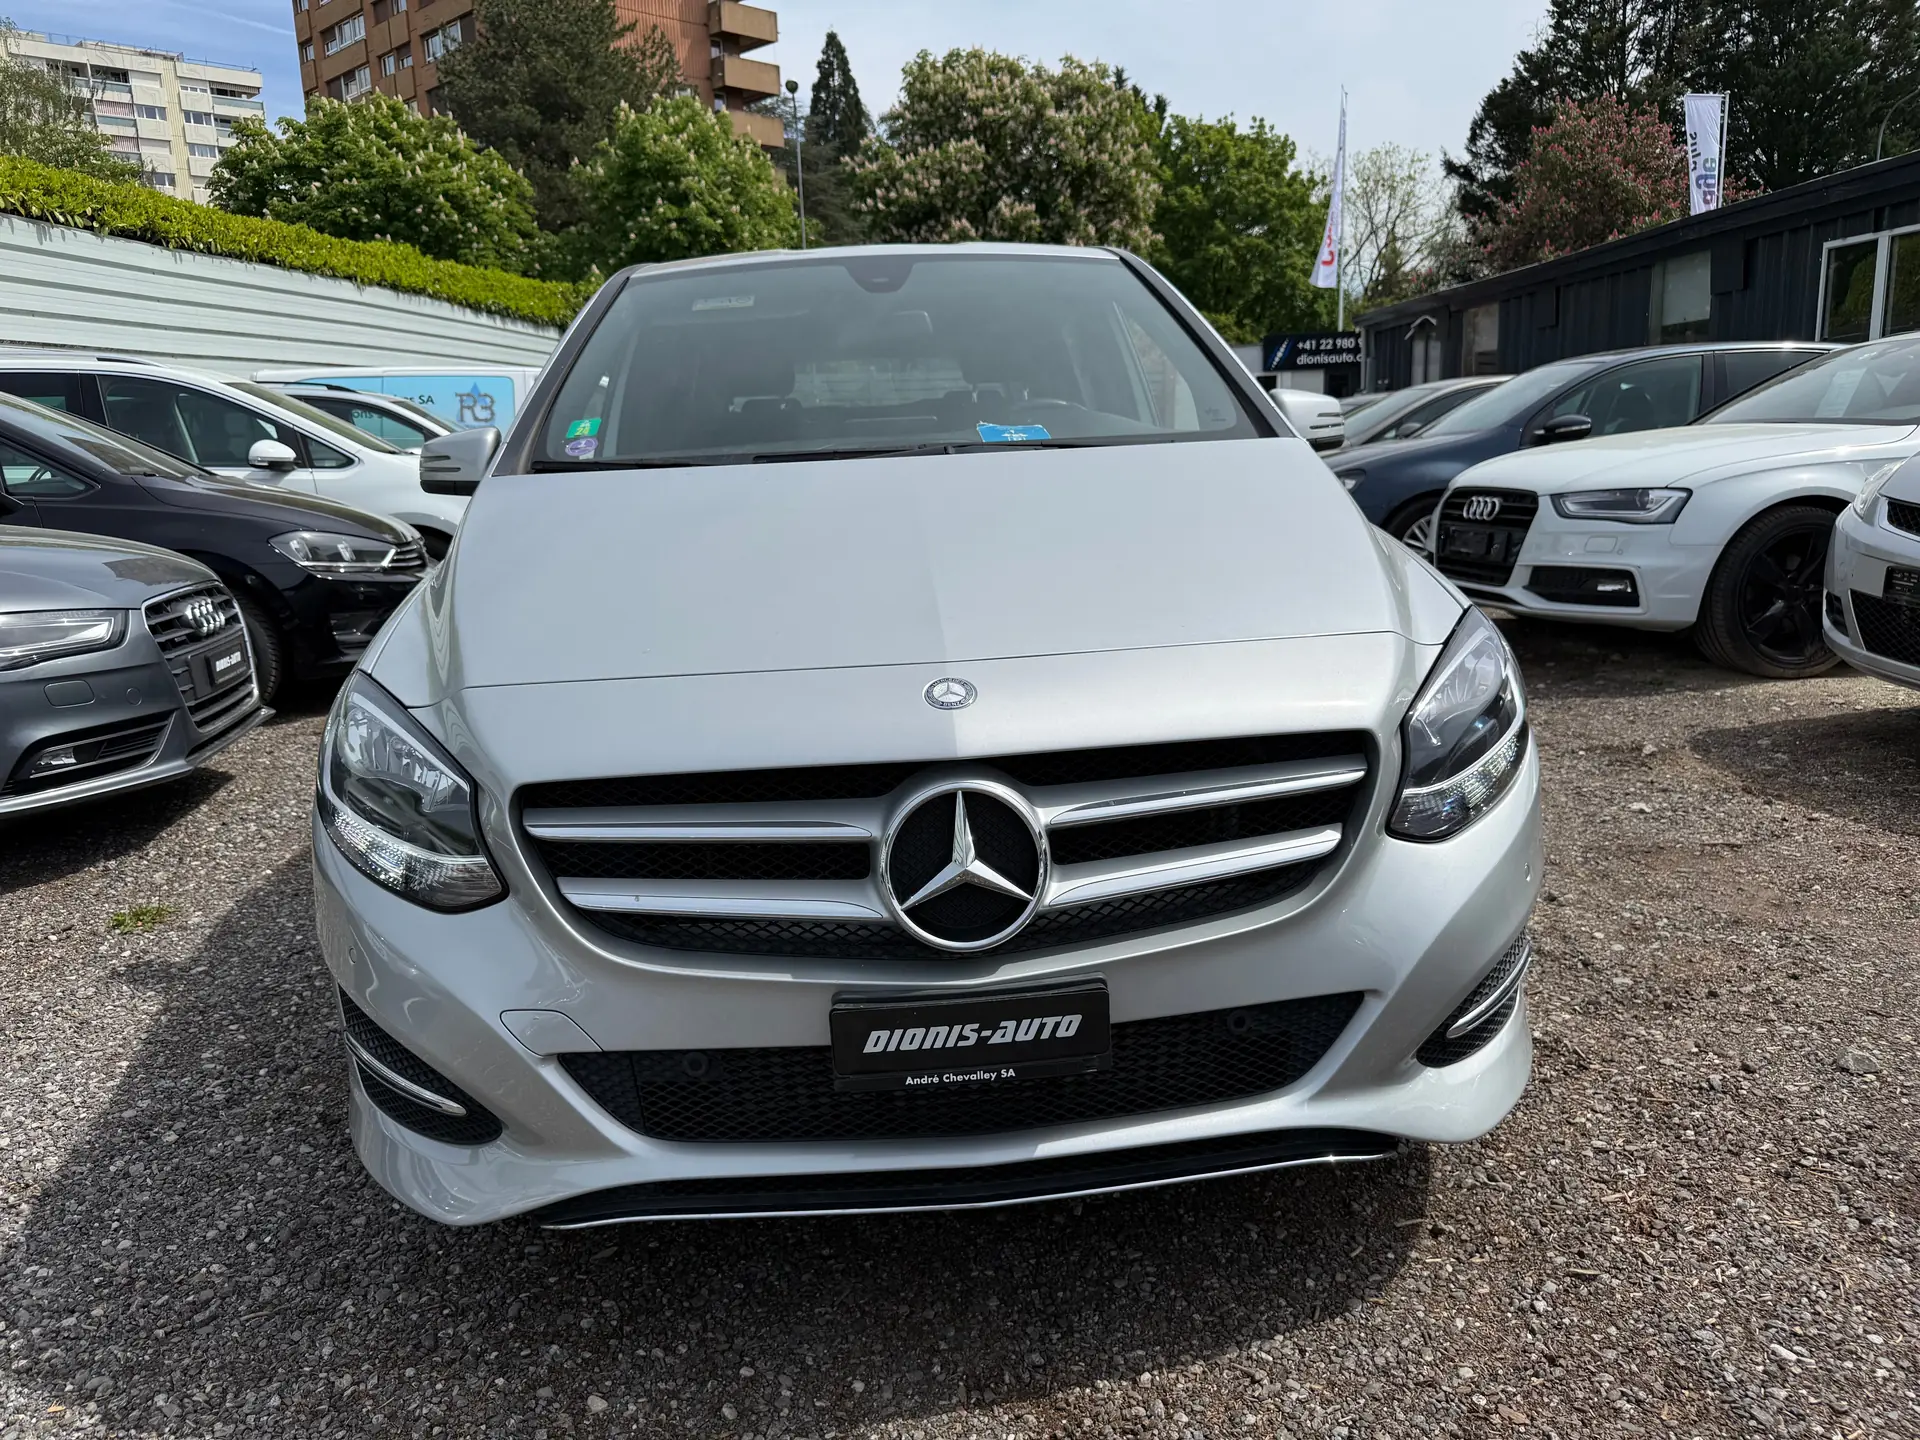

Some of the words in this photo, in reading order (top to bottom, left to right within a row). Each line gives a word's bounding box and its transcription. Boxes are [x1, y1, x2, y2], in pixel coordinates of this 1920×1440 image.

[1296, 340, 1316, 351] +41
[1320, 340, 1334, 350] 22
[1336, 338, 1355, 349] 980
[418, 394, 435, 405] SA
[862, 1014, 1083, 1054] DIONIS-AUTO
[905, 1074, 940, 1086] André
[943, 1070, 997, 1083] Chevalley
[1000, 1068, 1016, 1078] SA
